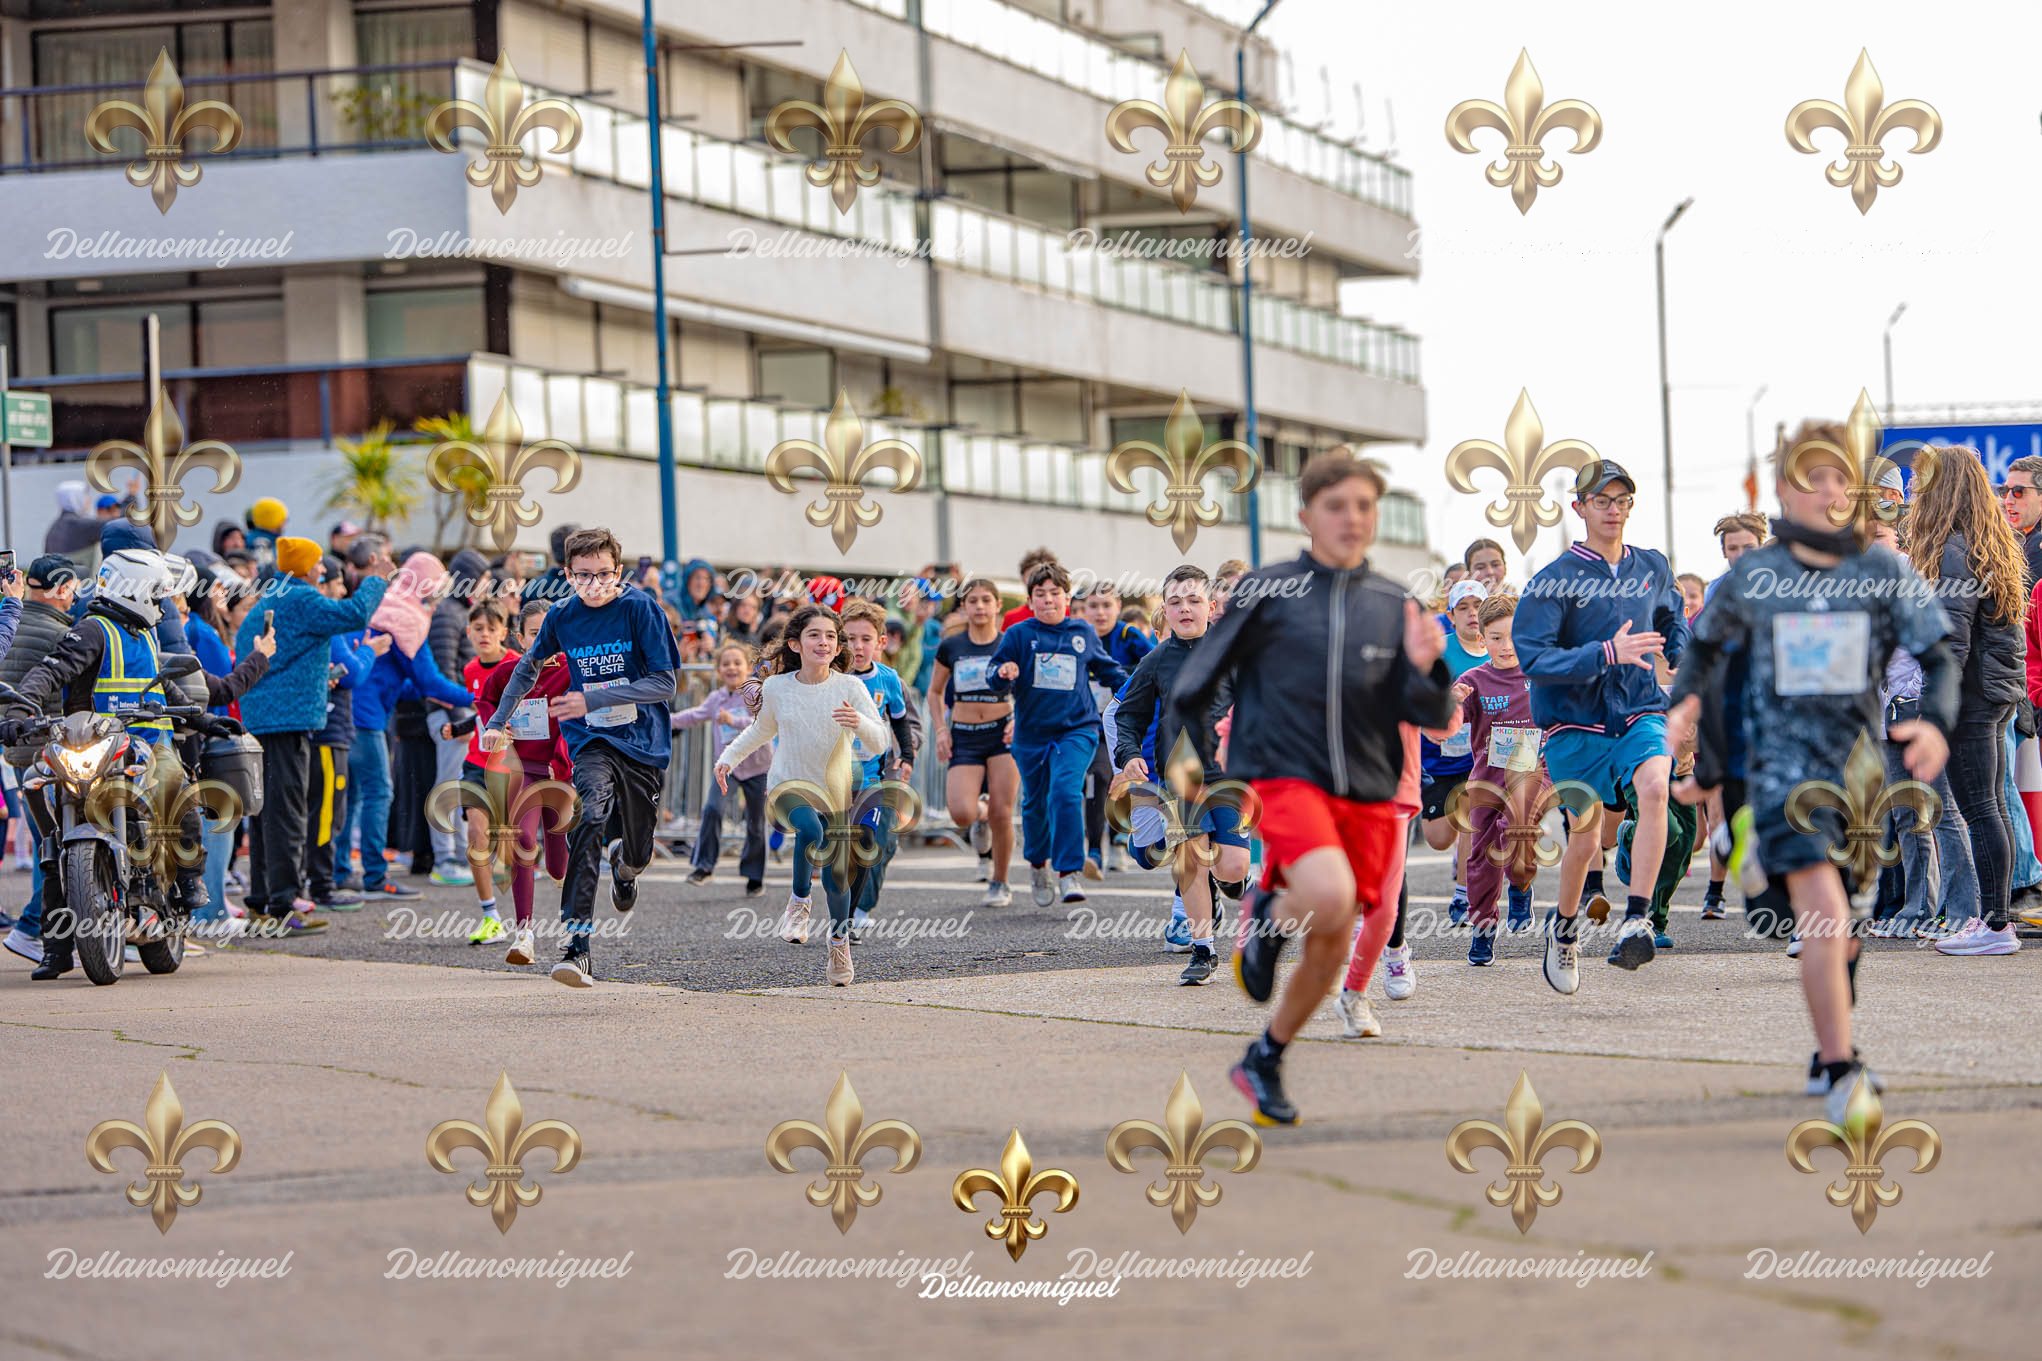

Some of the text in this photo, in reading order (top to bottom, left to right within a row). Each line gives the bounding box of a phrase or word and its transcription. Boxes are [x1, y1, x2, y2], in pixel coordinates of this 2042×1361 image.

[568, 640, 632, 658] MARATÓN
[577, 654, 624, 667] DE PUNTA
[581, 663, 625, 677] DEL ESTE
[1480, 695, 1510, 703] START
[1499, 727, 1536, 736] KIDS RUN
